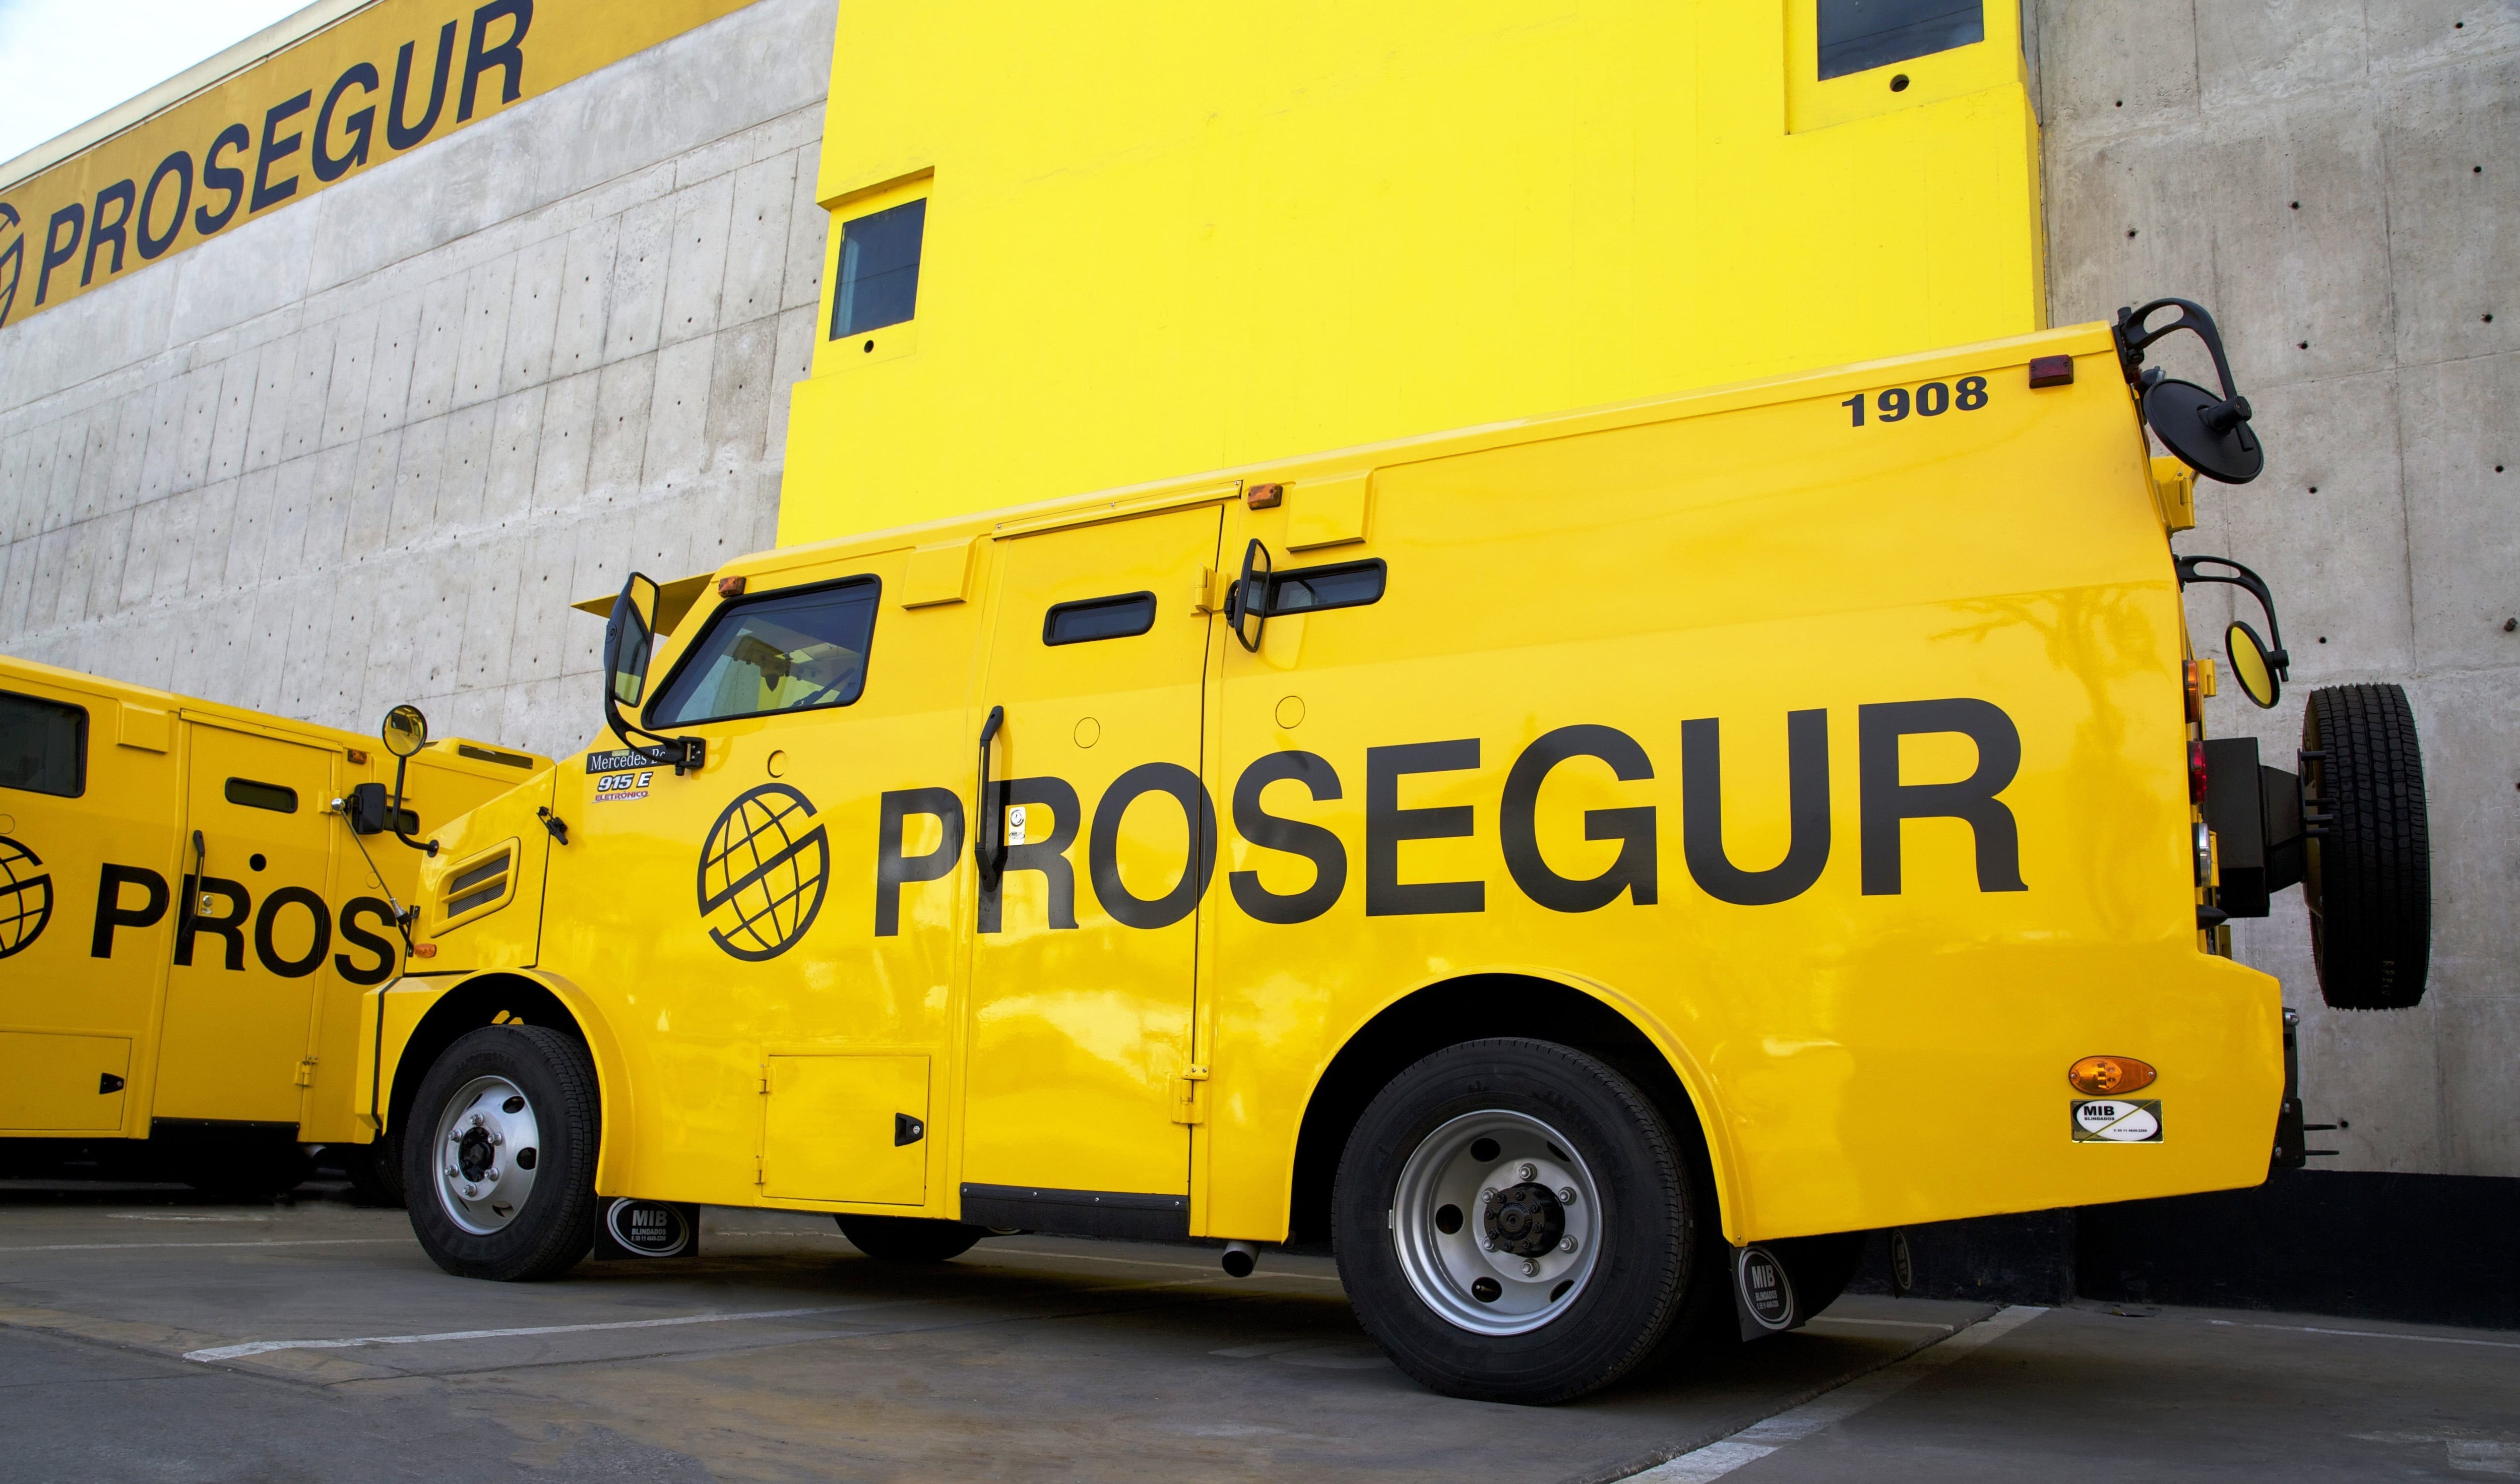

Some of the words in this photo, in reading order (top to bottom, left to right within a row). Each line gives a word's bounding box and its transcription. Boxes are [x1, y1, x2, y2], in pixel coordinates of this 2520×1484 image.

[35, 0, 533, 306] PROSEGUR
[1842, 376, 1988, 427] 1908
[590, 751, 647, 771] Mercedes
[598, 773, 635, 792] 915
[637, 772, 654, 788] E
[875, 698, 2029, 937] PROSEGUR
[2084, 1105, 2115, 1116] MIB
[632, 1209, 667, 1226] MIB
[1751, 1264, 1776, 1289] MIB
[1755, 1289, 1778, 1302] BLINDADOS
